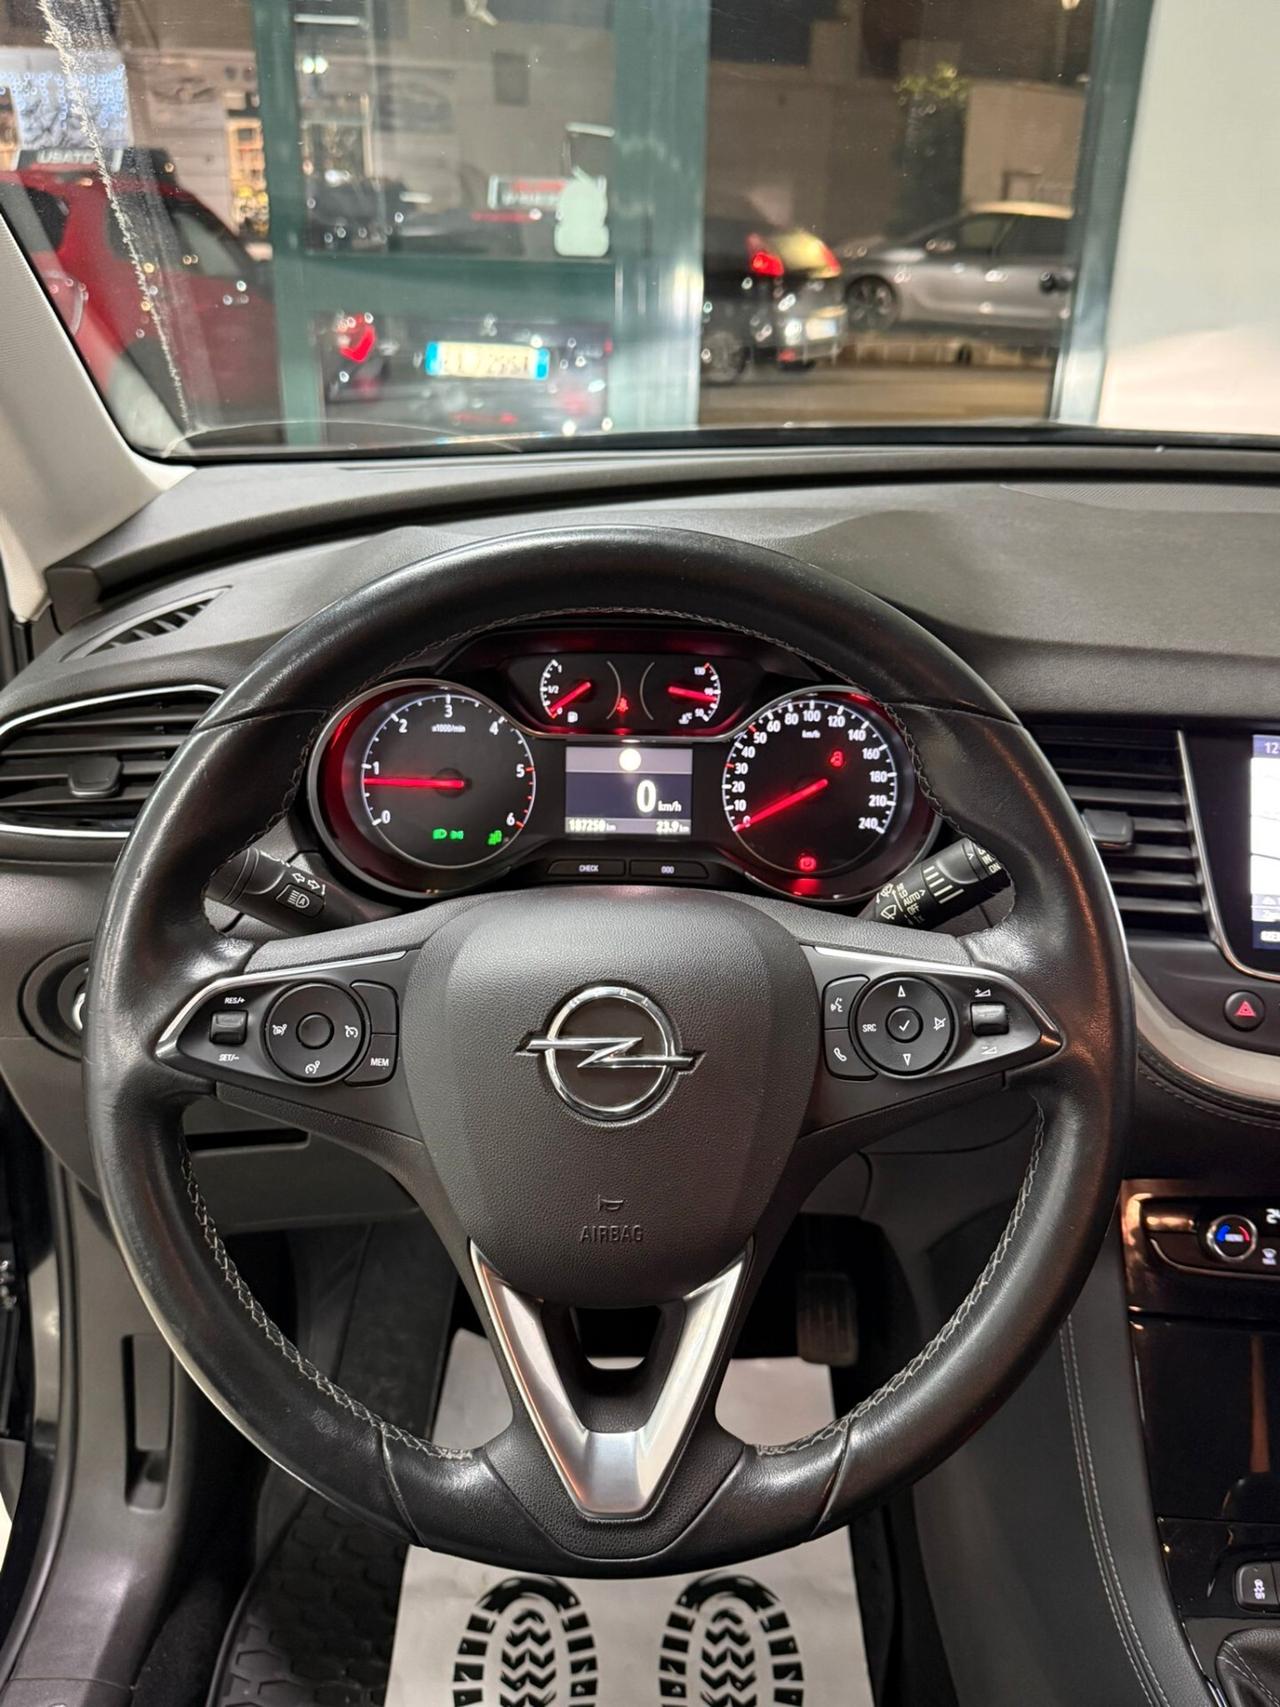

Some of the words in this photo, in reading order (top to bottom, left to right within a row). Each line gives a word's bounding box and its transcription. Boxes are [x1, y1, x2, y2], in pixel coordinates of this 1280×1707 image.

[557, 664, 562, 673] 1
[444, 705, 453, 718] 3
[803, 710, 821, 722] 100
[785, 713, 799, 725] 80
[828, 716, 845, 728] 120
[399, 719, 408, 733] 2
[432, 723, 466, 733] x1000/min
[489, 722, 499, 736] 4
[767, 720, 781, 733] 60
[754, 732, 768, 744] 50
[802, 730, 821, 739] km/h
[848, 730, 866, 742] 140
[742, 746, 756, 758] 40
[862, 748, 880, 760] 160
[373, 761, 380, 775] 1
[516, 764, 525, 778] 5
[735, 762, 748, 775] 30
[870, 771, 887, 783] 180
[732, 781, 745, 793] 20
[636, 780, 656, 813] 0
[658, 801, 682, 812] km/h
[869, 795, 887, 807] 210
[734, 799, 747, 811] 10
[381, 810, 391, 824] 0
[506, 812, 515, 826] 6
[743, 816, 752, 828] 0
[859, 818, 878, 830] 240
[579, 865, 599, 873] CHECK
[899, 889, 908, 899] LO
[902, 892, 921, 907] AUTO
[906, 903, 920, 916] OFF
[862, 1024, 877, 1033] SRC
[370, 1057, 389, 1067] MEM
[580, 1224, 643, 1241] AIRBAG
